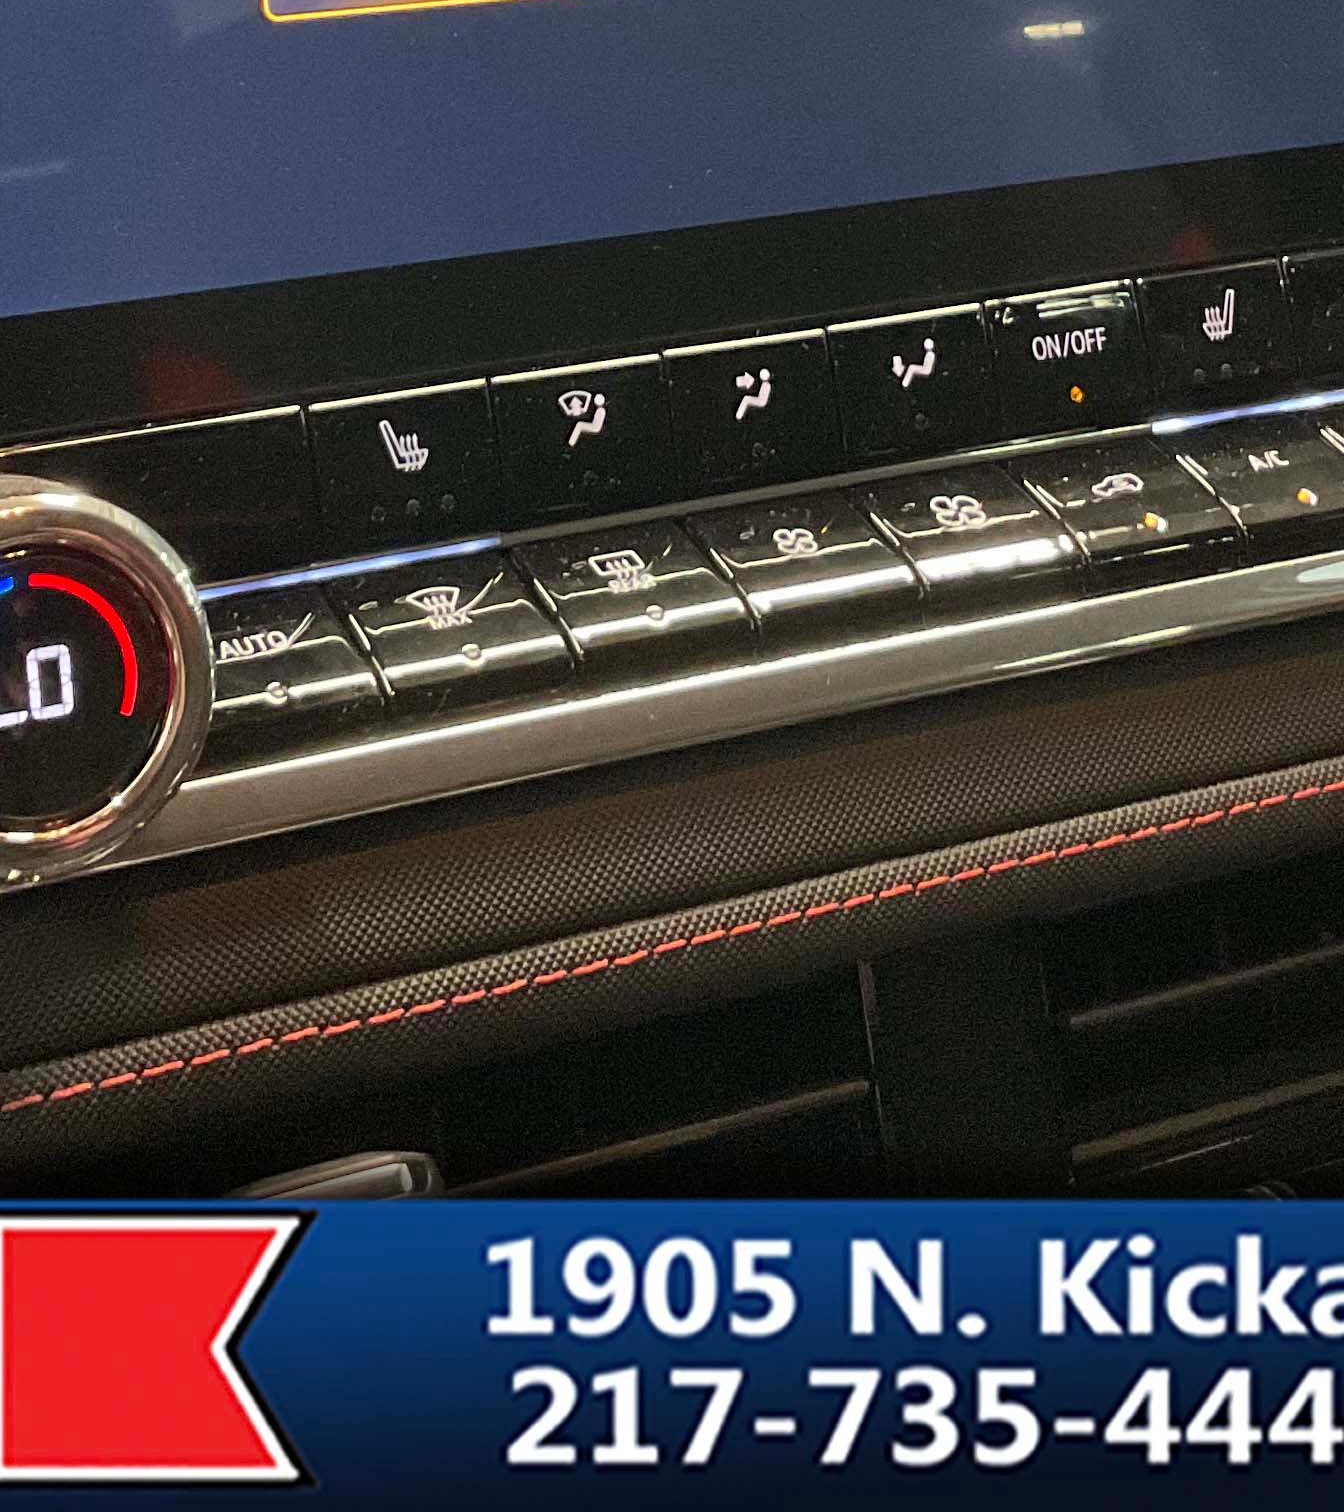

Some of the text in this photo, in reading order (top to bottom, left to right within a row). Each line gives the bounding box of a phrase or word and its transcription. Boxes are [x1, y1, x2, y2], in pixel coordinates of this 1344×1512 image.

[1032, 326, 1107, 361] ON/OFF
[1248, 449, 1290, 472] A/C
[219, 630, 288, 661] AUTO
